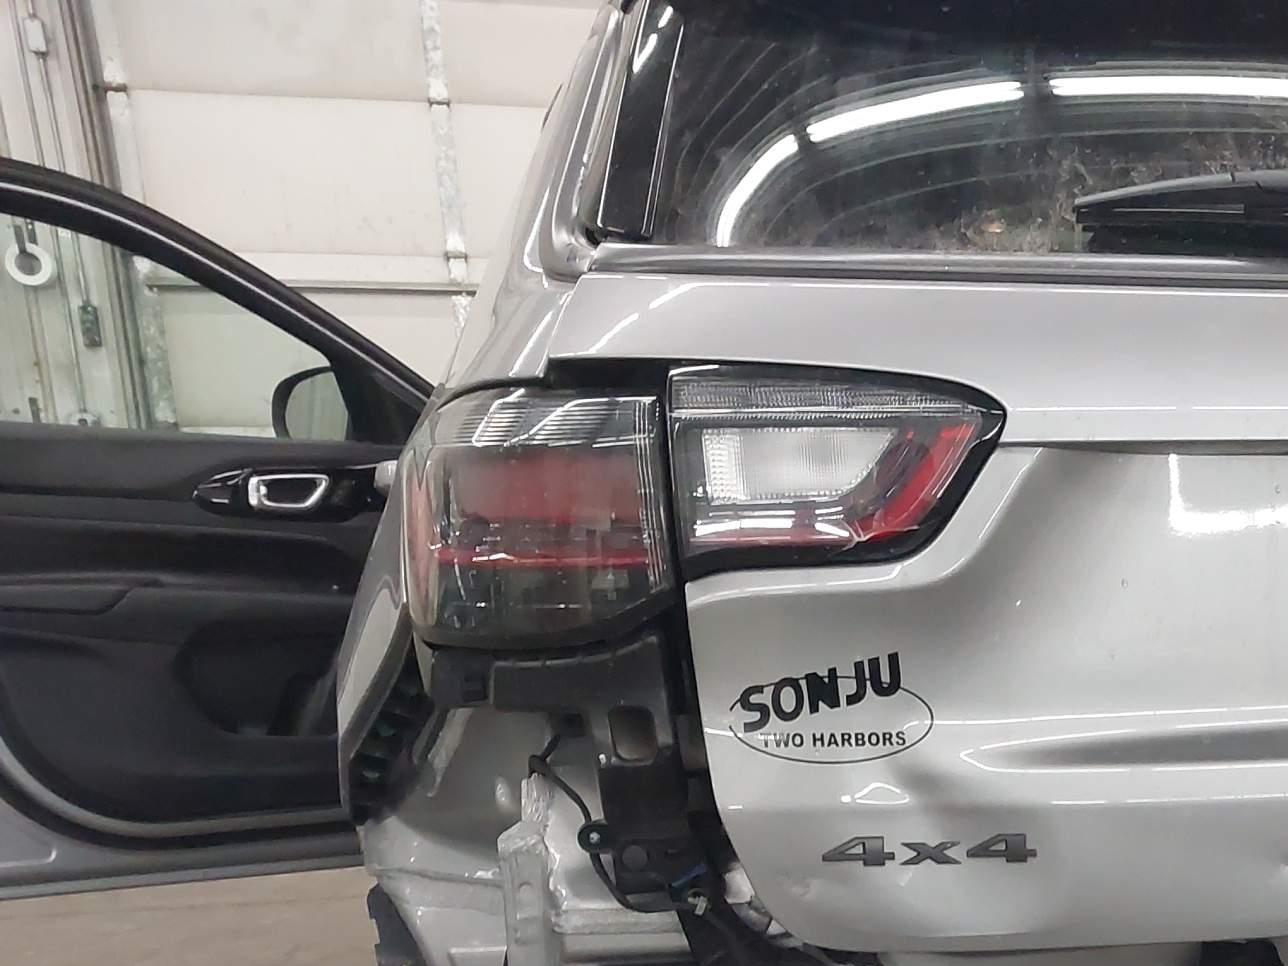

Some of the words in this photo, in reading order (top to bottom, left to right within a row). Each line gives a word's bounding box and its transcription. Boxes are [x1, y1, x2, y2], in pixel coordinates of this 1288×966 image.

[740, 652, 901, 733] SONJU
[760, 732, 804, 748] TWO
[812, 731, 906, 748] HARBORS
[822, 833, 1038, 867] 4x4
